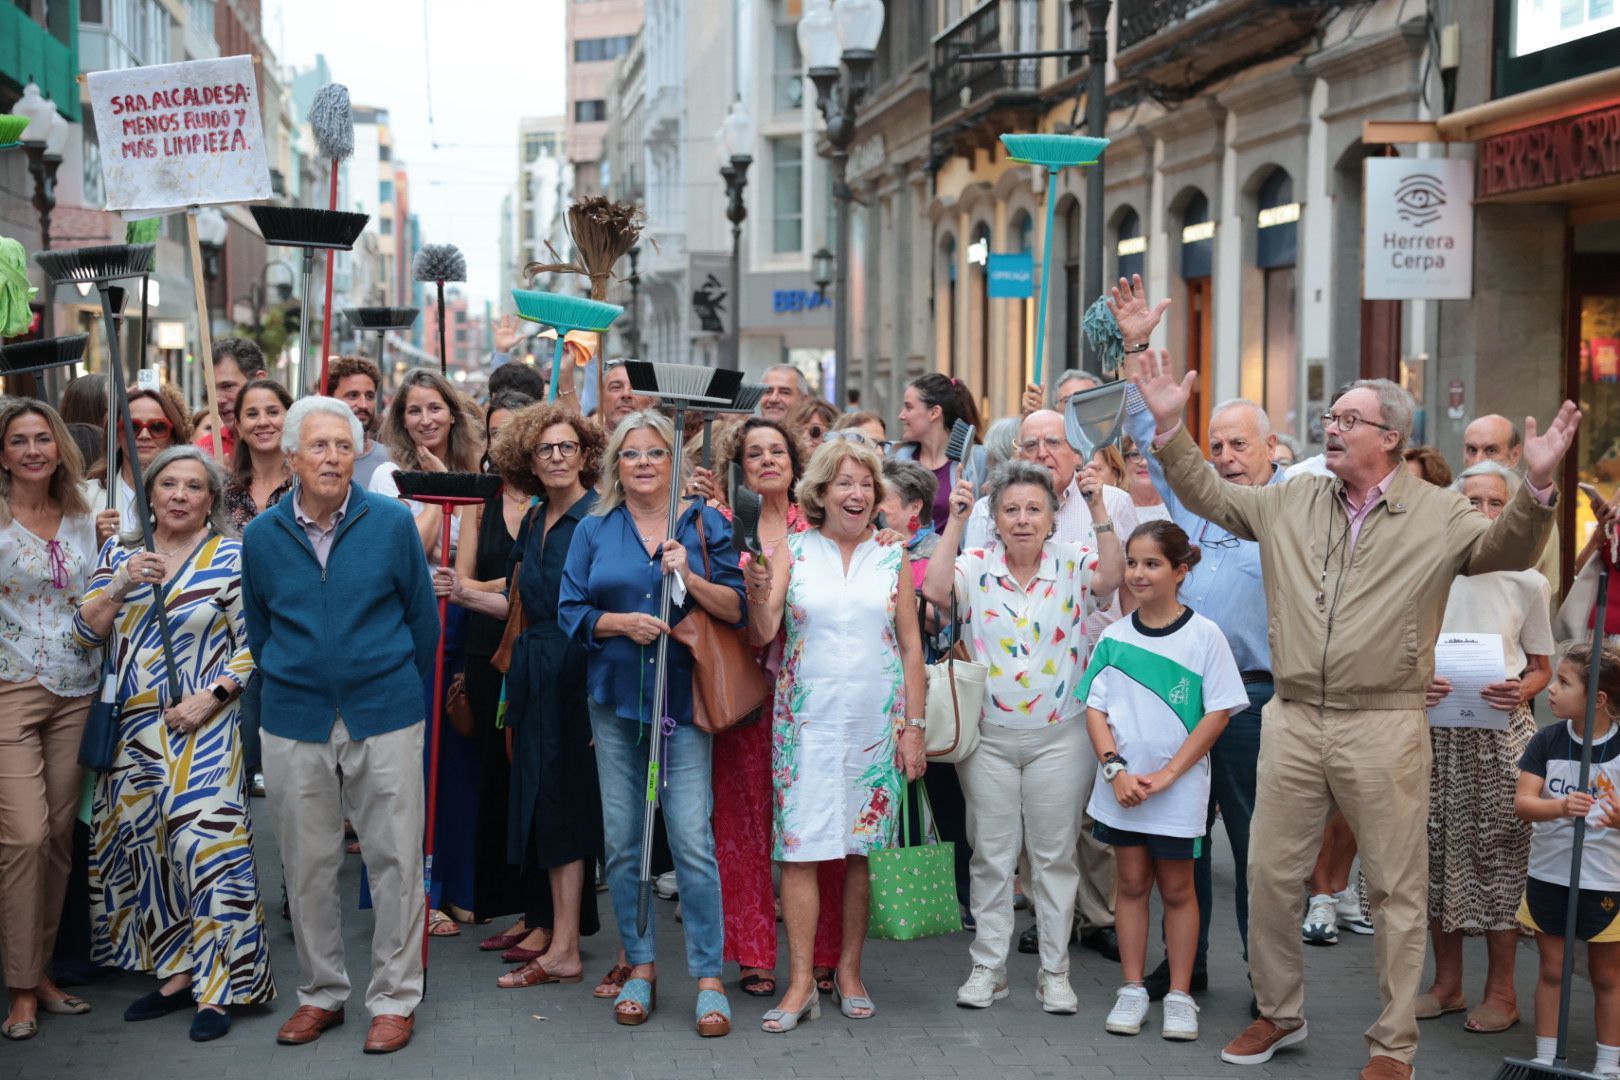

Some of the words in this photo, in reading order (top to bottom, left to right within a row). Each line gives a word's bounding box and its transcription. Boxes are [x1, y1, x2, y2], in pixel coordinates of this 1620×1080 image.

[122, 112, 180, 136] MENOS
[184, 109, 231, 130] RUIDO
[121, 136, 158, 159] MÁS
[163, 128, 251, 157] LIMPIEZA.
[1383, 232, 1455, 250] Herrera
[1391, 251, 1446, 272] Cerpa
[1549, 778, 1598, 800] Clat
